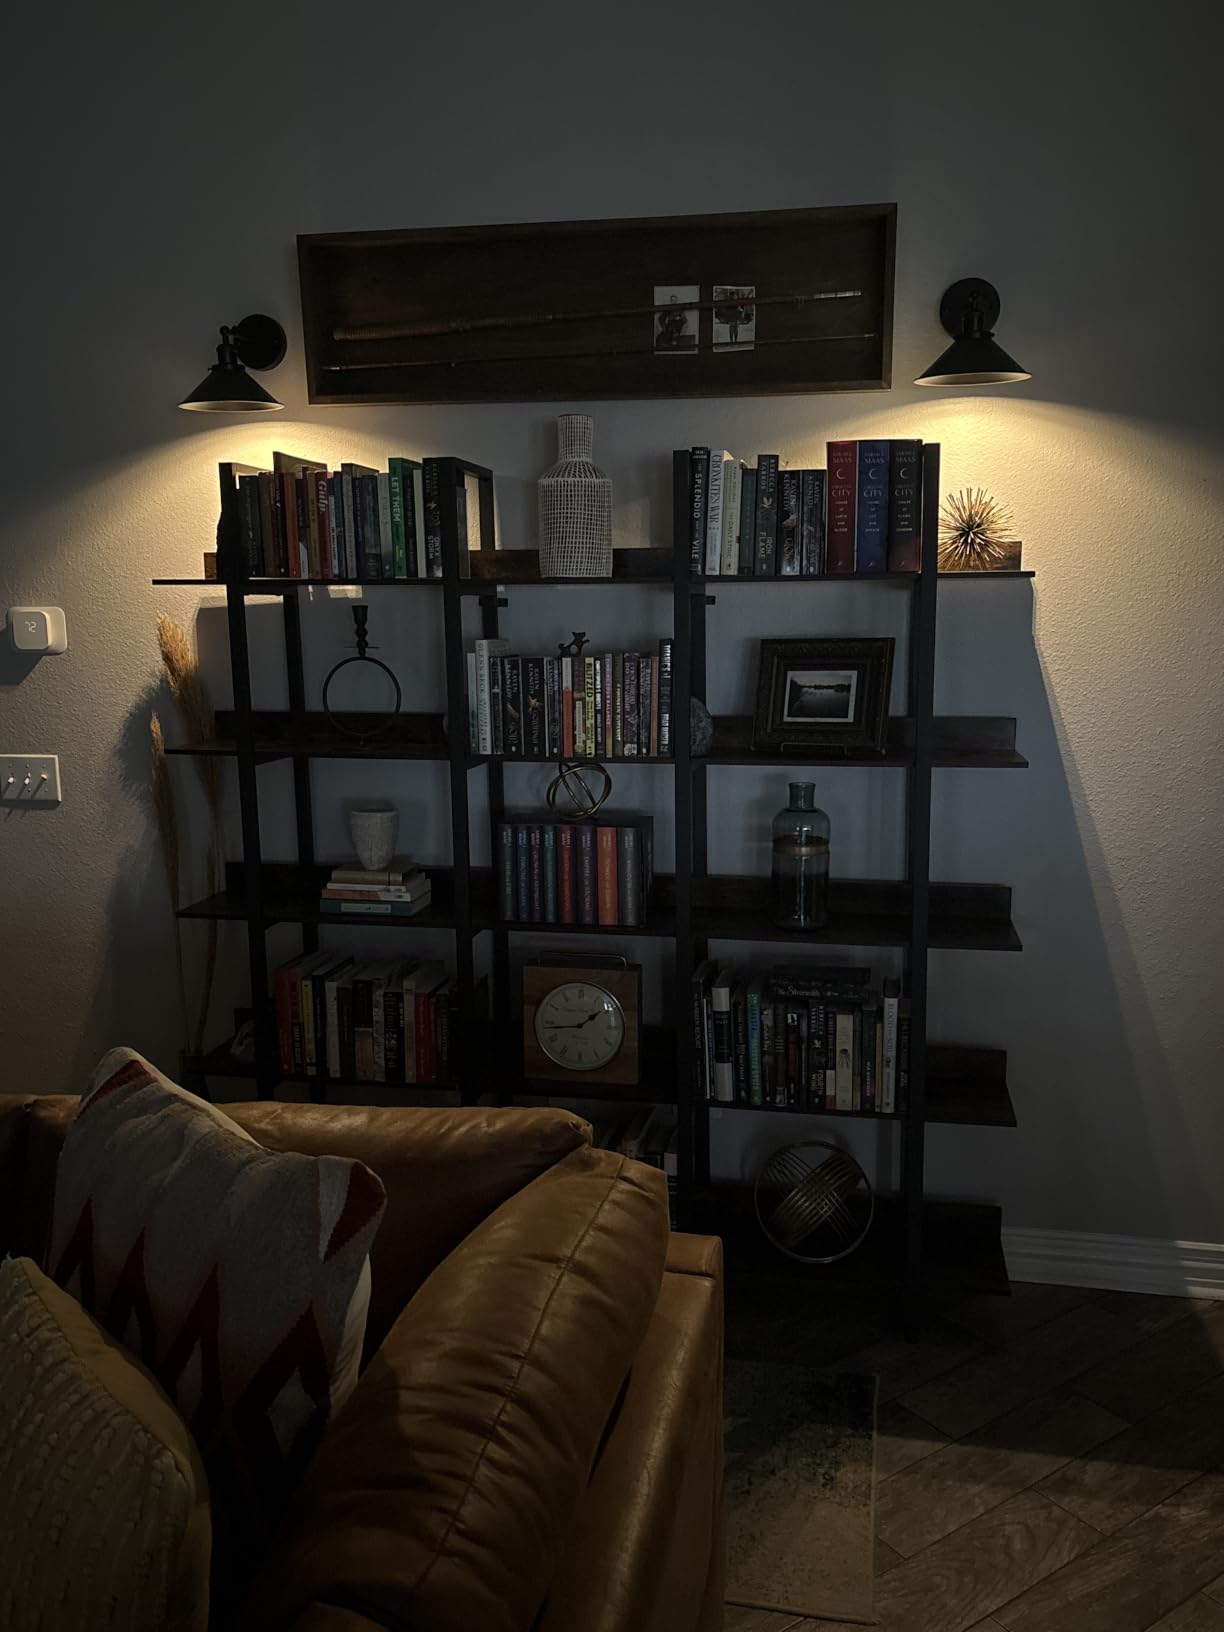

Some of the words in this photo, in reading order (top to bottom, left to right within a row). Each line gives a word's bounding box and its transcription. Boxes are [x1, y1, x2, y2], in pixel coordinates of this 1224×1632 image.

[391, 477, 399, 492] LET
[832, 489, 850, 497] CITY
[864, 489, 882, 497] CITY
[318, 481, 328, 515] Gulp.
[693, 473, 703, 519] SPLENDID
[393, 495, 401, 521] THEM
[709, 505, 720, 523] WAR
[692, 540, 700, 559] VILE
[24, 621, 37, 633] 72
